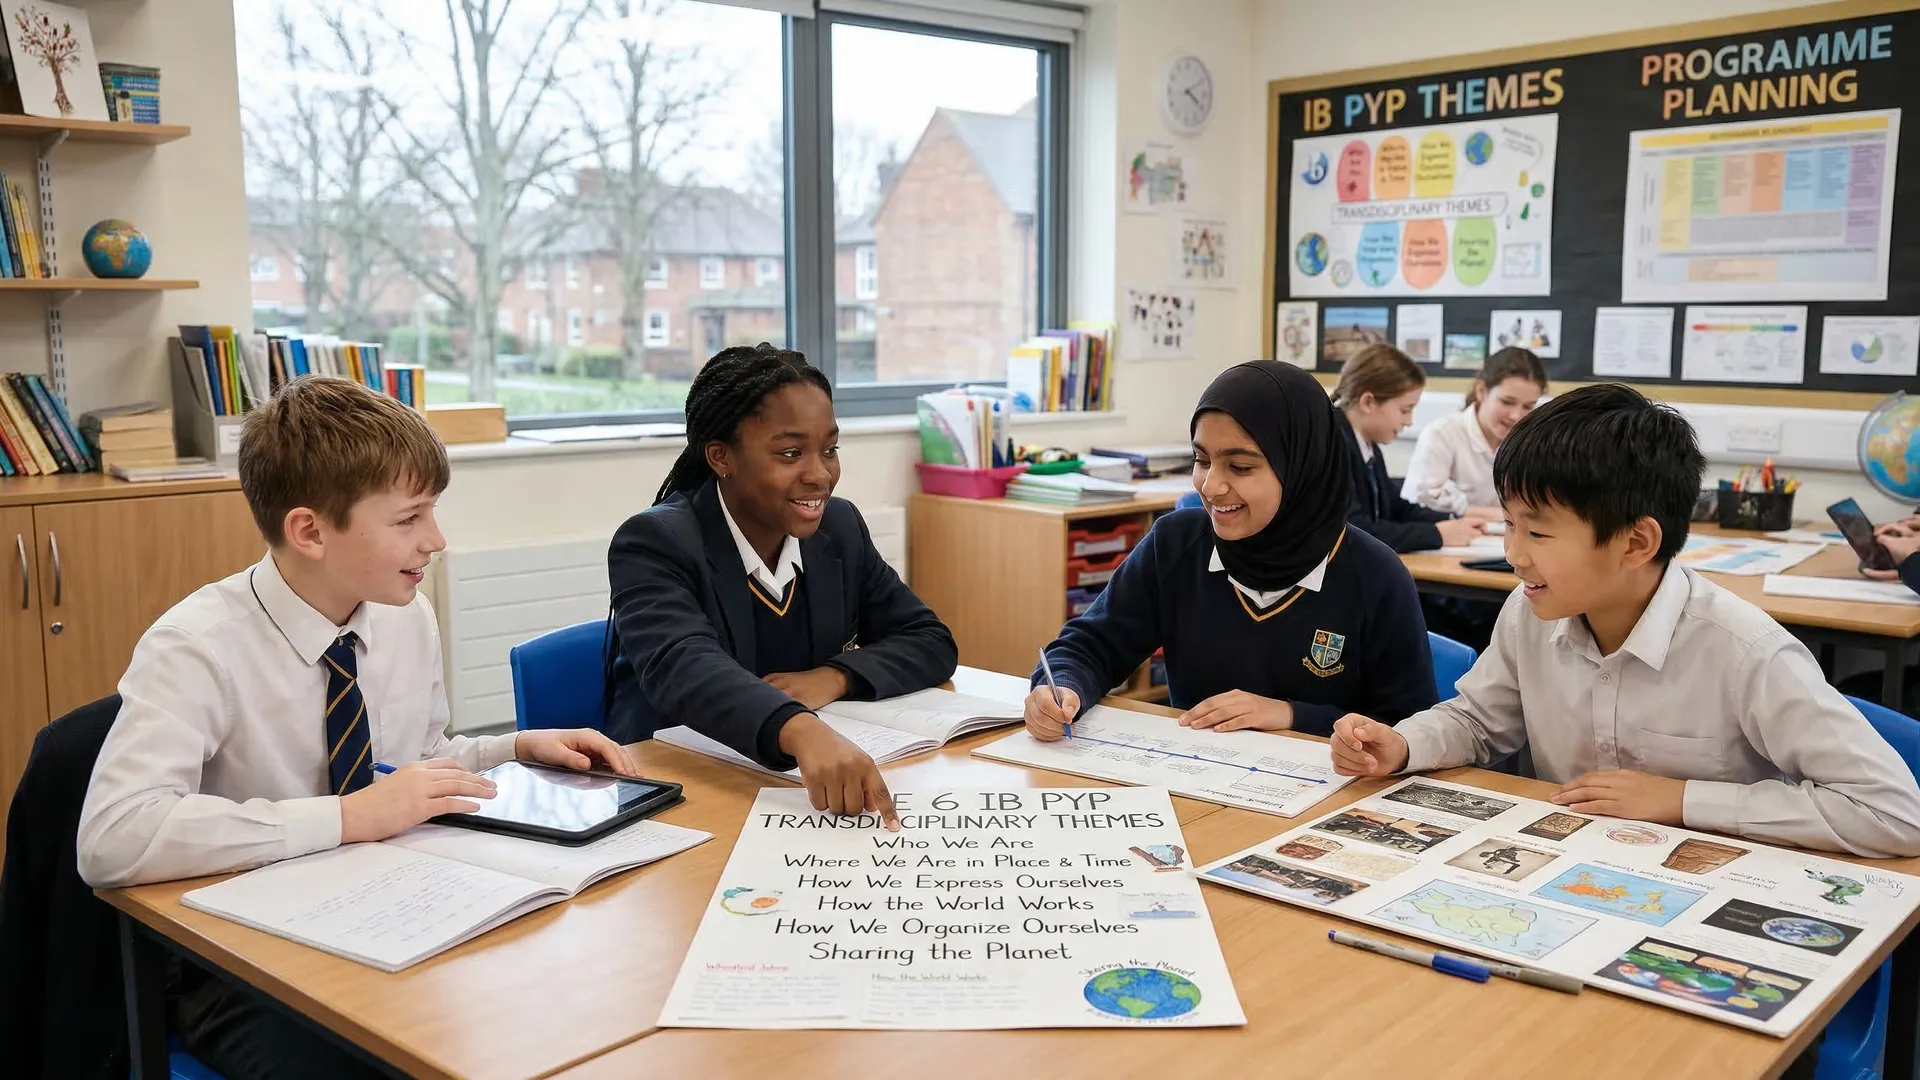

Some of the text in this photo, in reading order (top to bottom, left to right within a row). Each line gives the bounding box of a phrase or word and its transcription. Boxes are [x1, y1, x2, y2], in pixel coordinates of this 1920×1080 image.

[1641, 24, 1893, 87] PROGRAMME
[1303, 68, 1564, 132] IB PYP THEMES
[1663, 69, 1858, 120] PLANNING
[932, 793, 959, 811] 6
[982, 793, 1023, 811] IB
[1041, 792, 1111, 811] PYP
[760, 813, 1164, 829] TRANSDICIPLINARY THEMES
[873, 836, 1034, 849] Who We Are
[784, 854, 1131, 868] Where We Are in Place & Time
[798, 874, 1124, 892] How We Express Ourselves
[818, 895, 1094, 911] How the World Works
[775, 917, 1139, 939] How We Organize Ourselves
[809, 942, 1072, 966] Sharing the Planet
[1129, 958, 1150, 967] the
[1156, 960, 1195, 977] Planet
